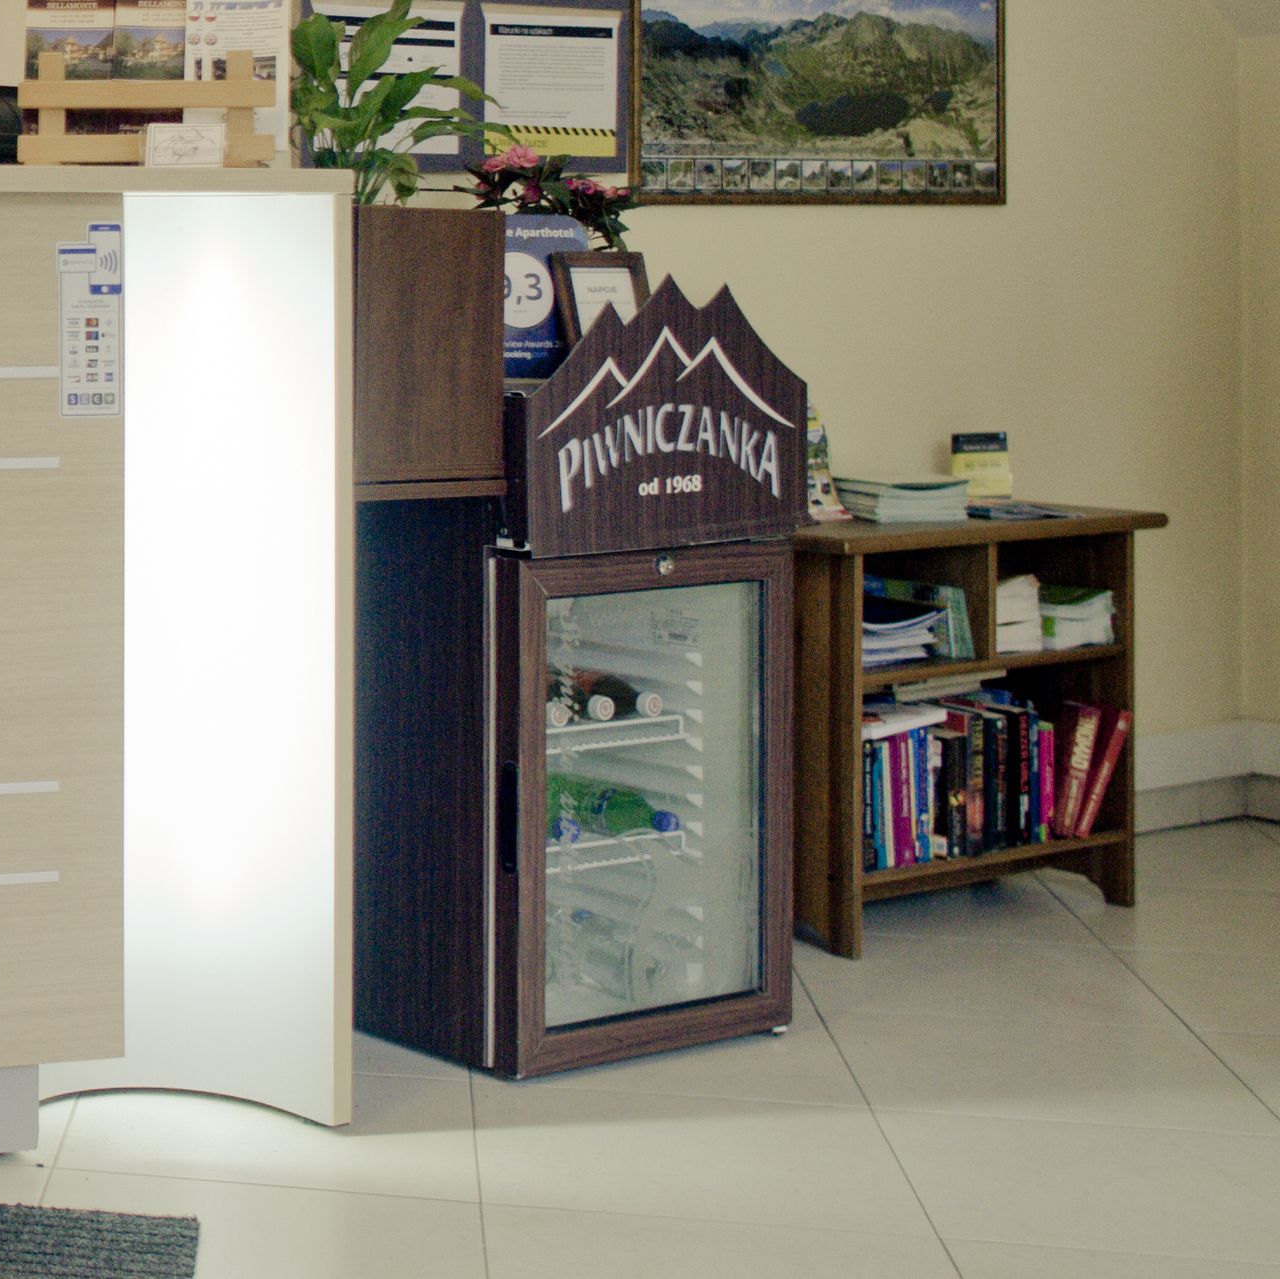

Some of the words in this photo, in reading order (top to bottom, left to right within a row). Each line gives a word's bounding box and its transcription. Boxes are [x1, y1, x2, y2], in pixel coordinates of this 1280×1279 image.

[138, 0, 186, 8] BELLAMONT
[515, 228, 574, 240] Aparthotel
[558, 403, 782, 513] PIWNICZANKA
[639, 477, 659, 496] od
[665, 474, 703, 494] 1968
